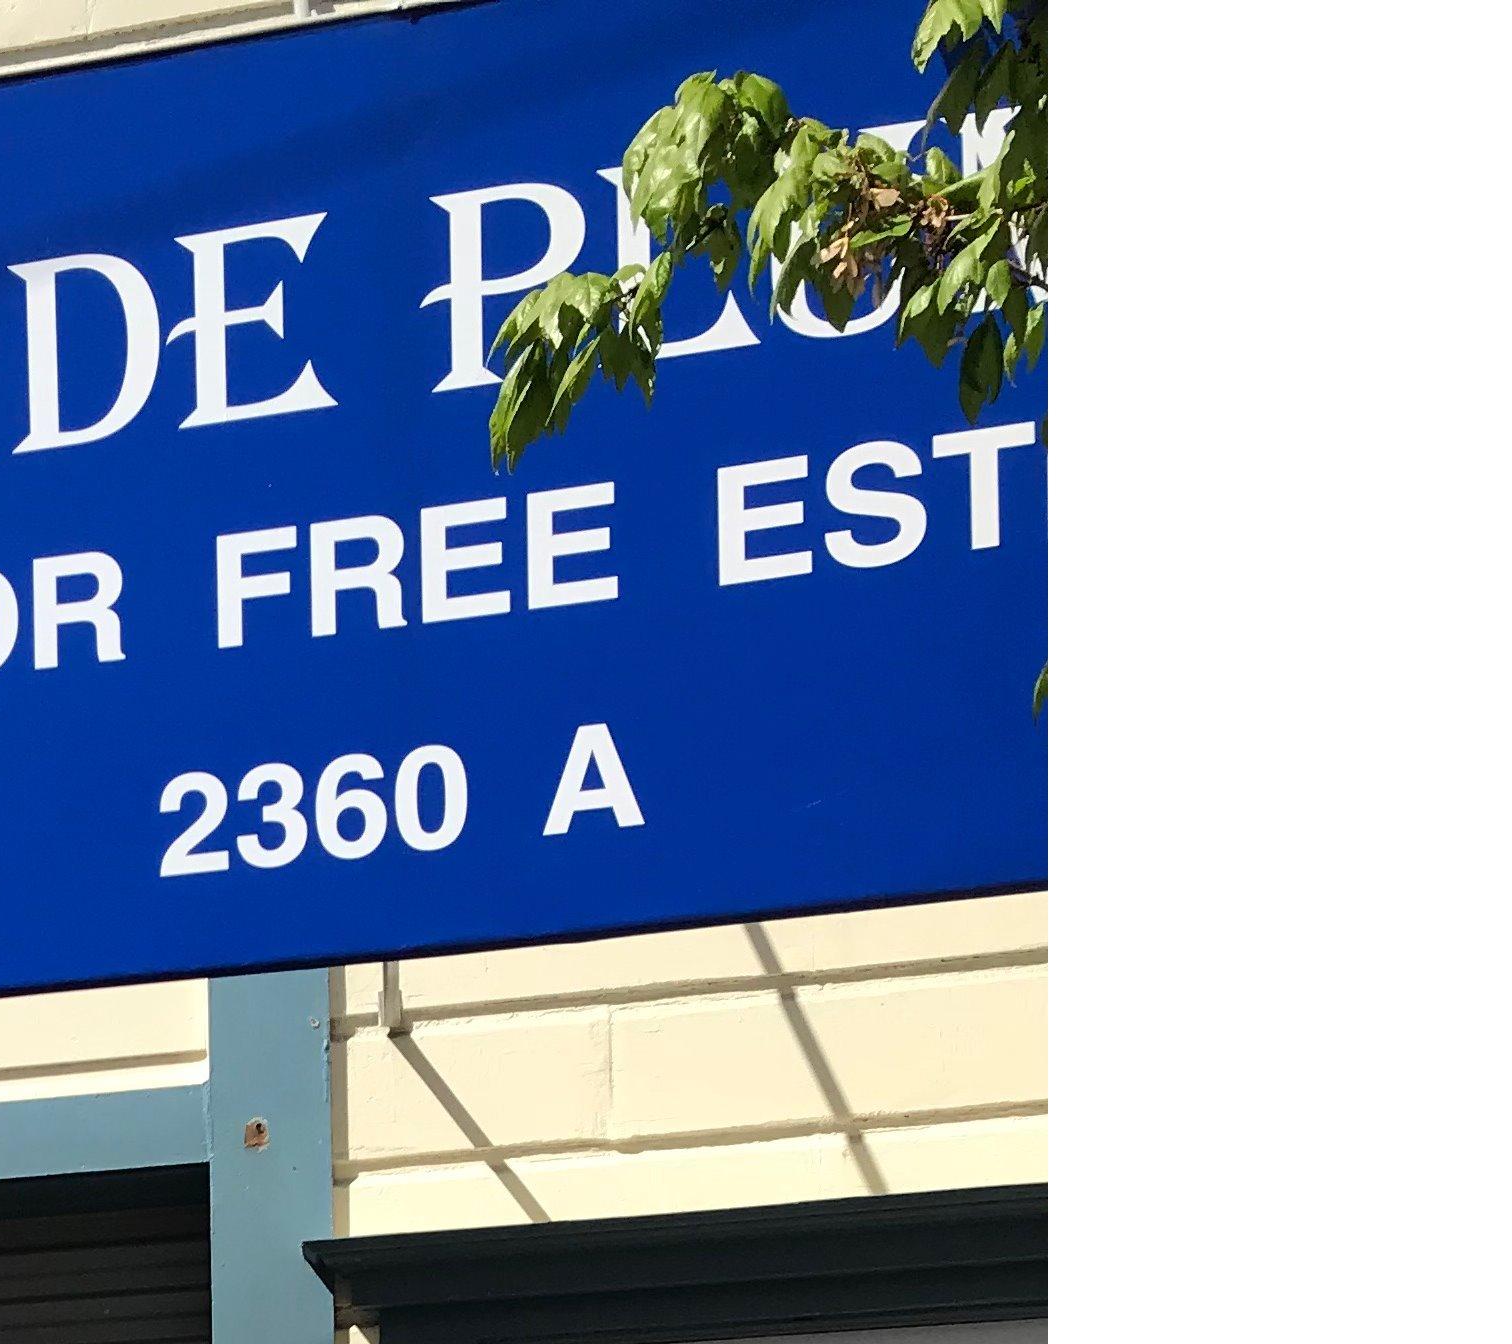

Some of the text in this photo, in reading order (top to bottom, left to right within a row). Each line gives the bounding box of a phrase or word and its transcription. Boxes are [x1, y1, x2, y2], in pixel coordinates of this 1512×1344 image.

[215, 481, 619, 649] FREE
[716, 420, 1036, 587] EST
[159, 722, 646, 878] 2360 A
